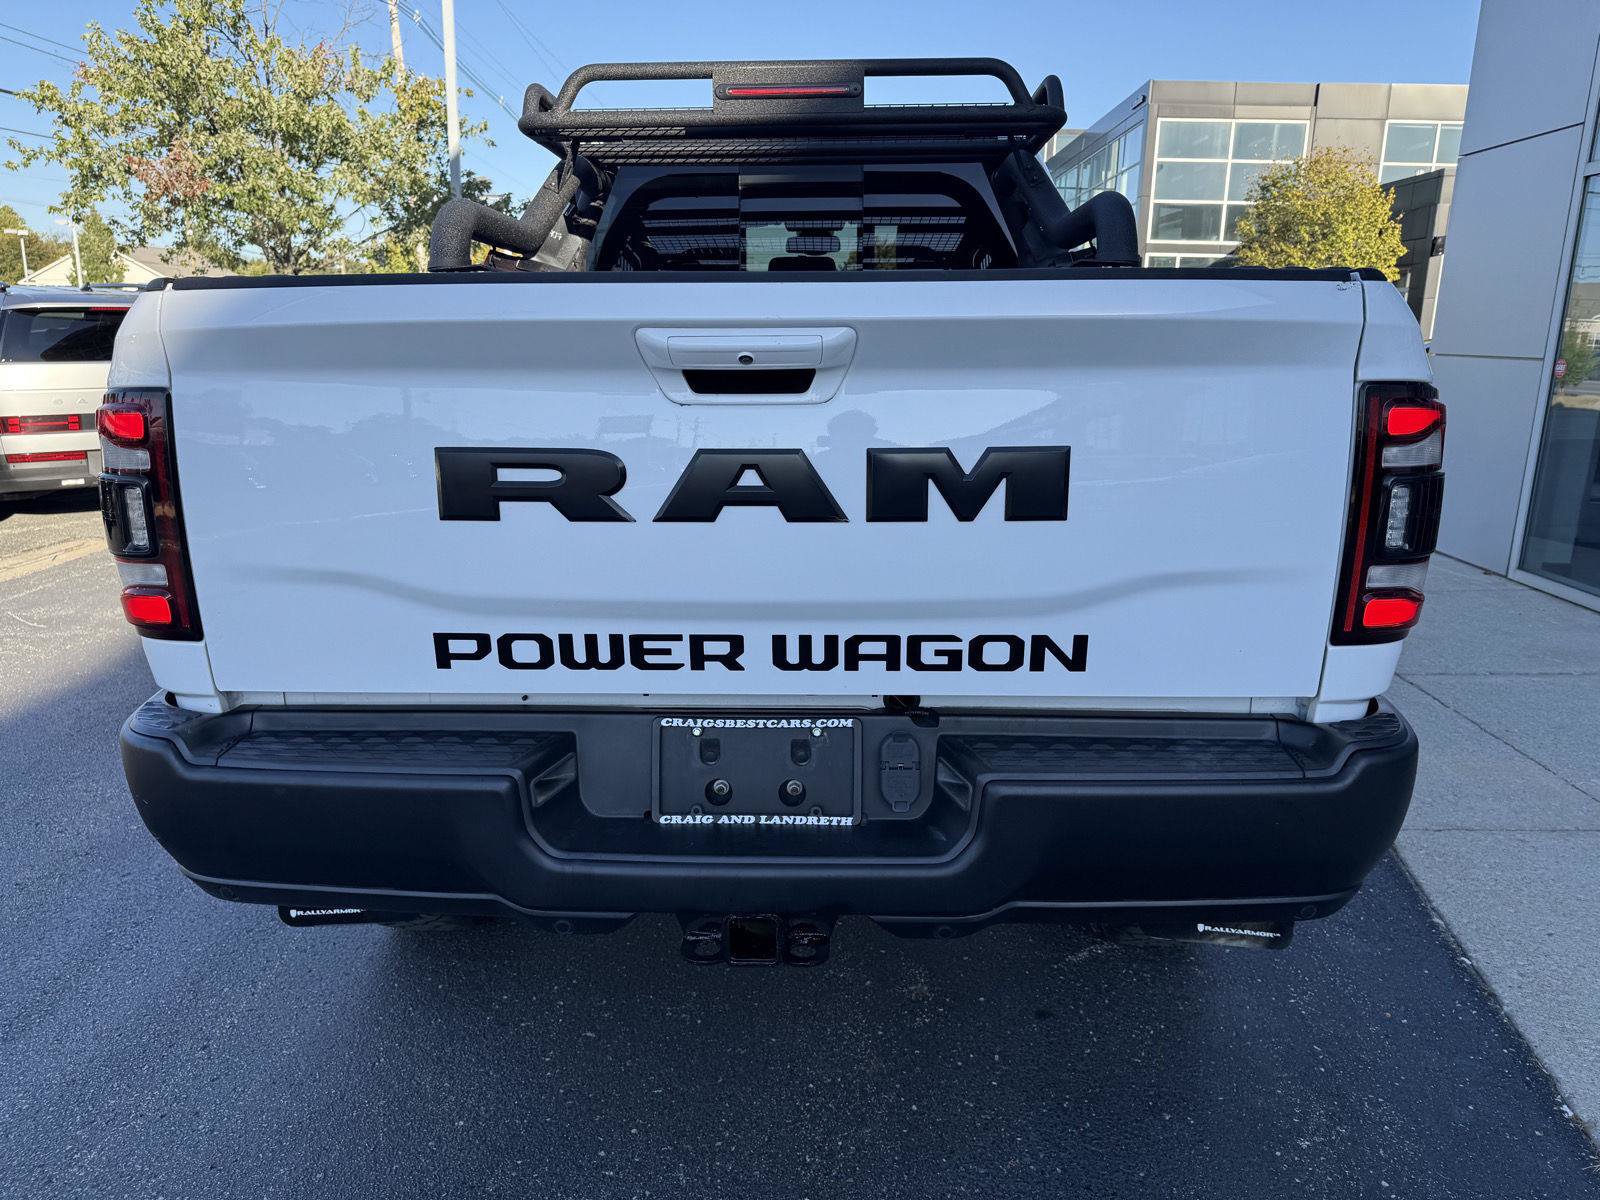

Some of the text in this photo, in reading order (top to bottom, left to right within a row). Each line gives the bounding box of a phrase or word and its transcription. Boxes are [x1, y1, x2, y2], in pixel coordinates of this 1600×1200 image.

[434, 445, 1071, 523] RAM
[433, 632, 1089, 672] POWER WAGON
[660, 717, 854, 728] CRAIGSBESTCARS.COM
[659, 815, 854, 826] CRAIG AND LANDRETH
[1204, 925, 1274, 938] RALLYARMOR
